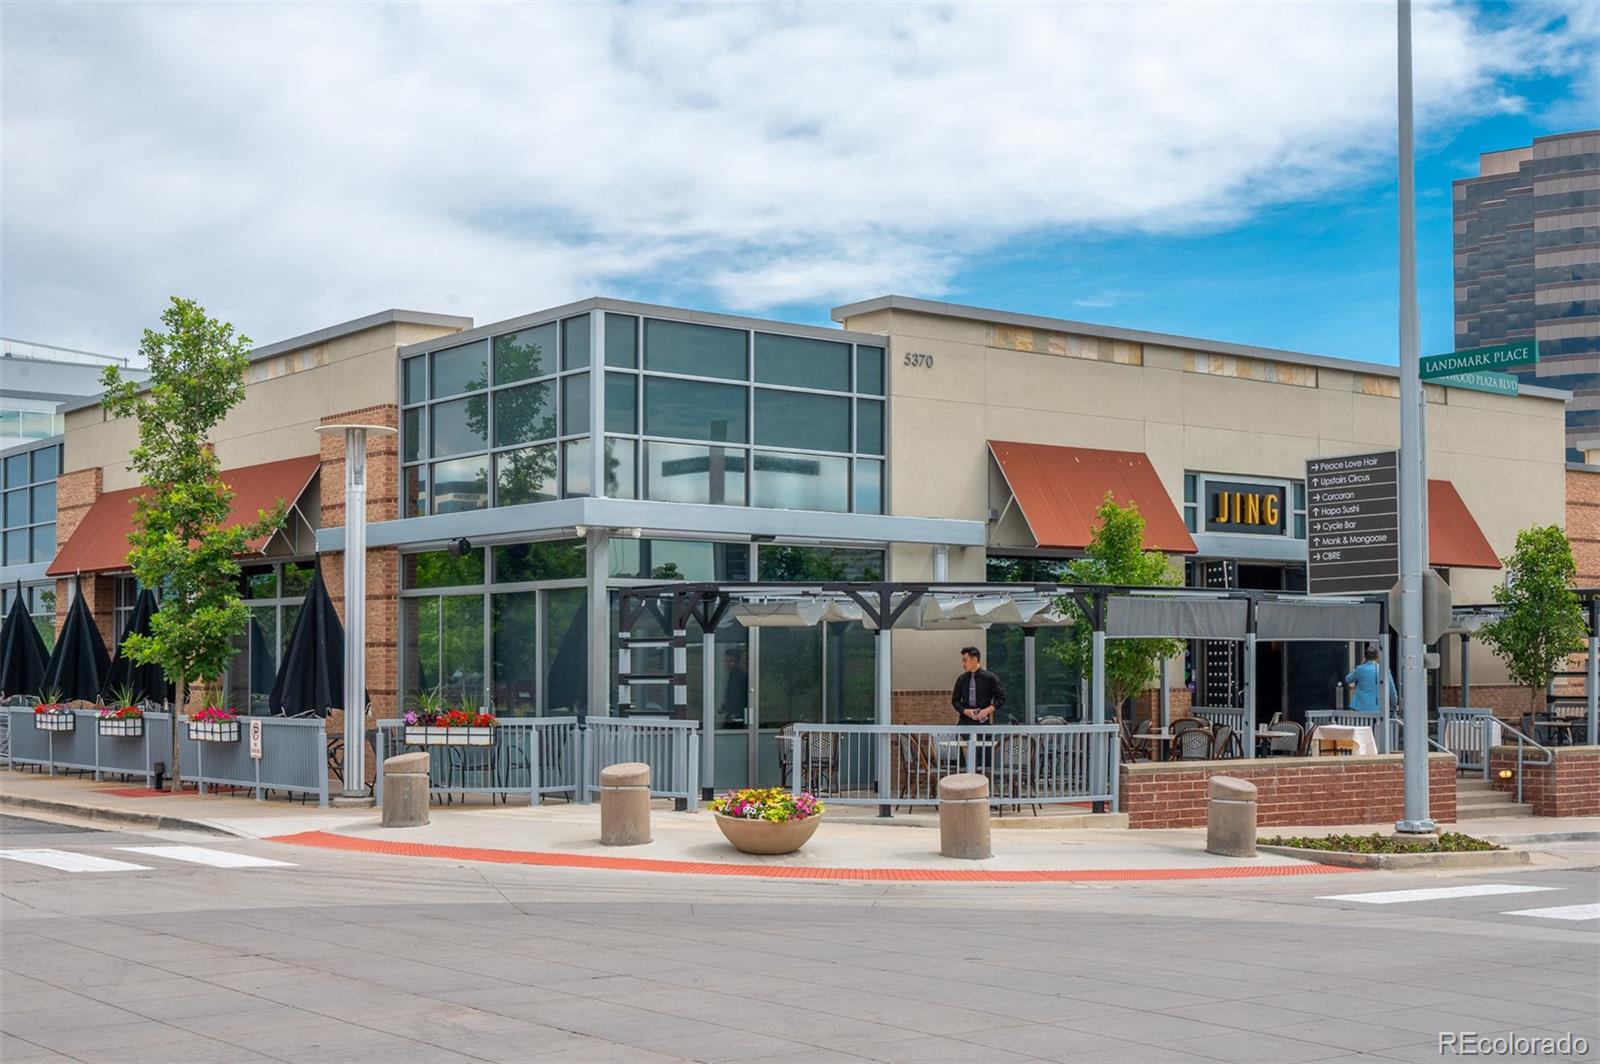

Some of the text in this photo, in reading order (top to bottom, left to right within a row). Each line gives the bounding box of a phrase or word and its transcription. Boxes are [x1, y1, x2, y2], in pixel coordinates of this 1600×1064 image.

[903, 352, 934, 368] 5370
[1426, 347, 1529, 372] LANDMARK PLACE
[1476, 375, 1497, 387] PLAZA
[1498, 378, 1518, 390] BLVD
[1320, 457, 1379, 471] Peace Love Hair
[1320, 473, 1370, 487] Upstairs Circus
[1321, 491, 1355, 502] Corcoran
[1216, 491, 1279, 526] JING
[1321, 504, 1360, 517] Hapa Sushi
[1322, 520, 1357, 532] Cycle Bar
[1322, 534, 1388, 545] Monk & Mongoose
[1322, 551, 1341, 561] CBRE
